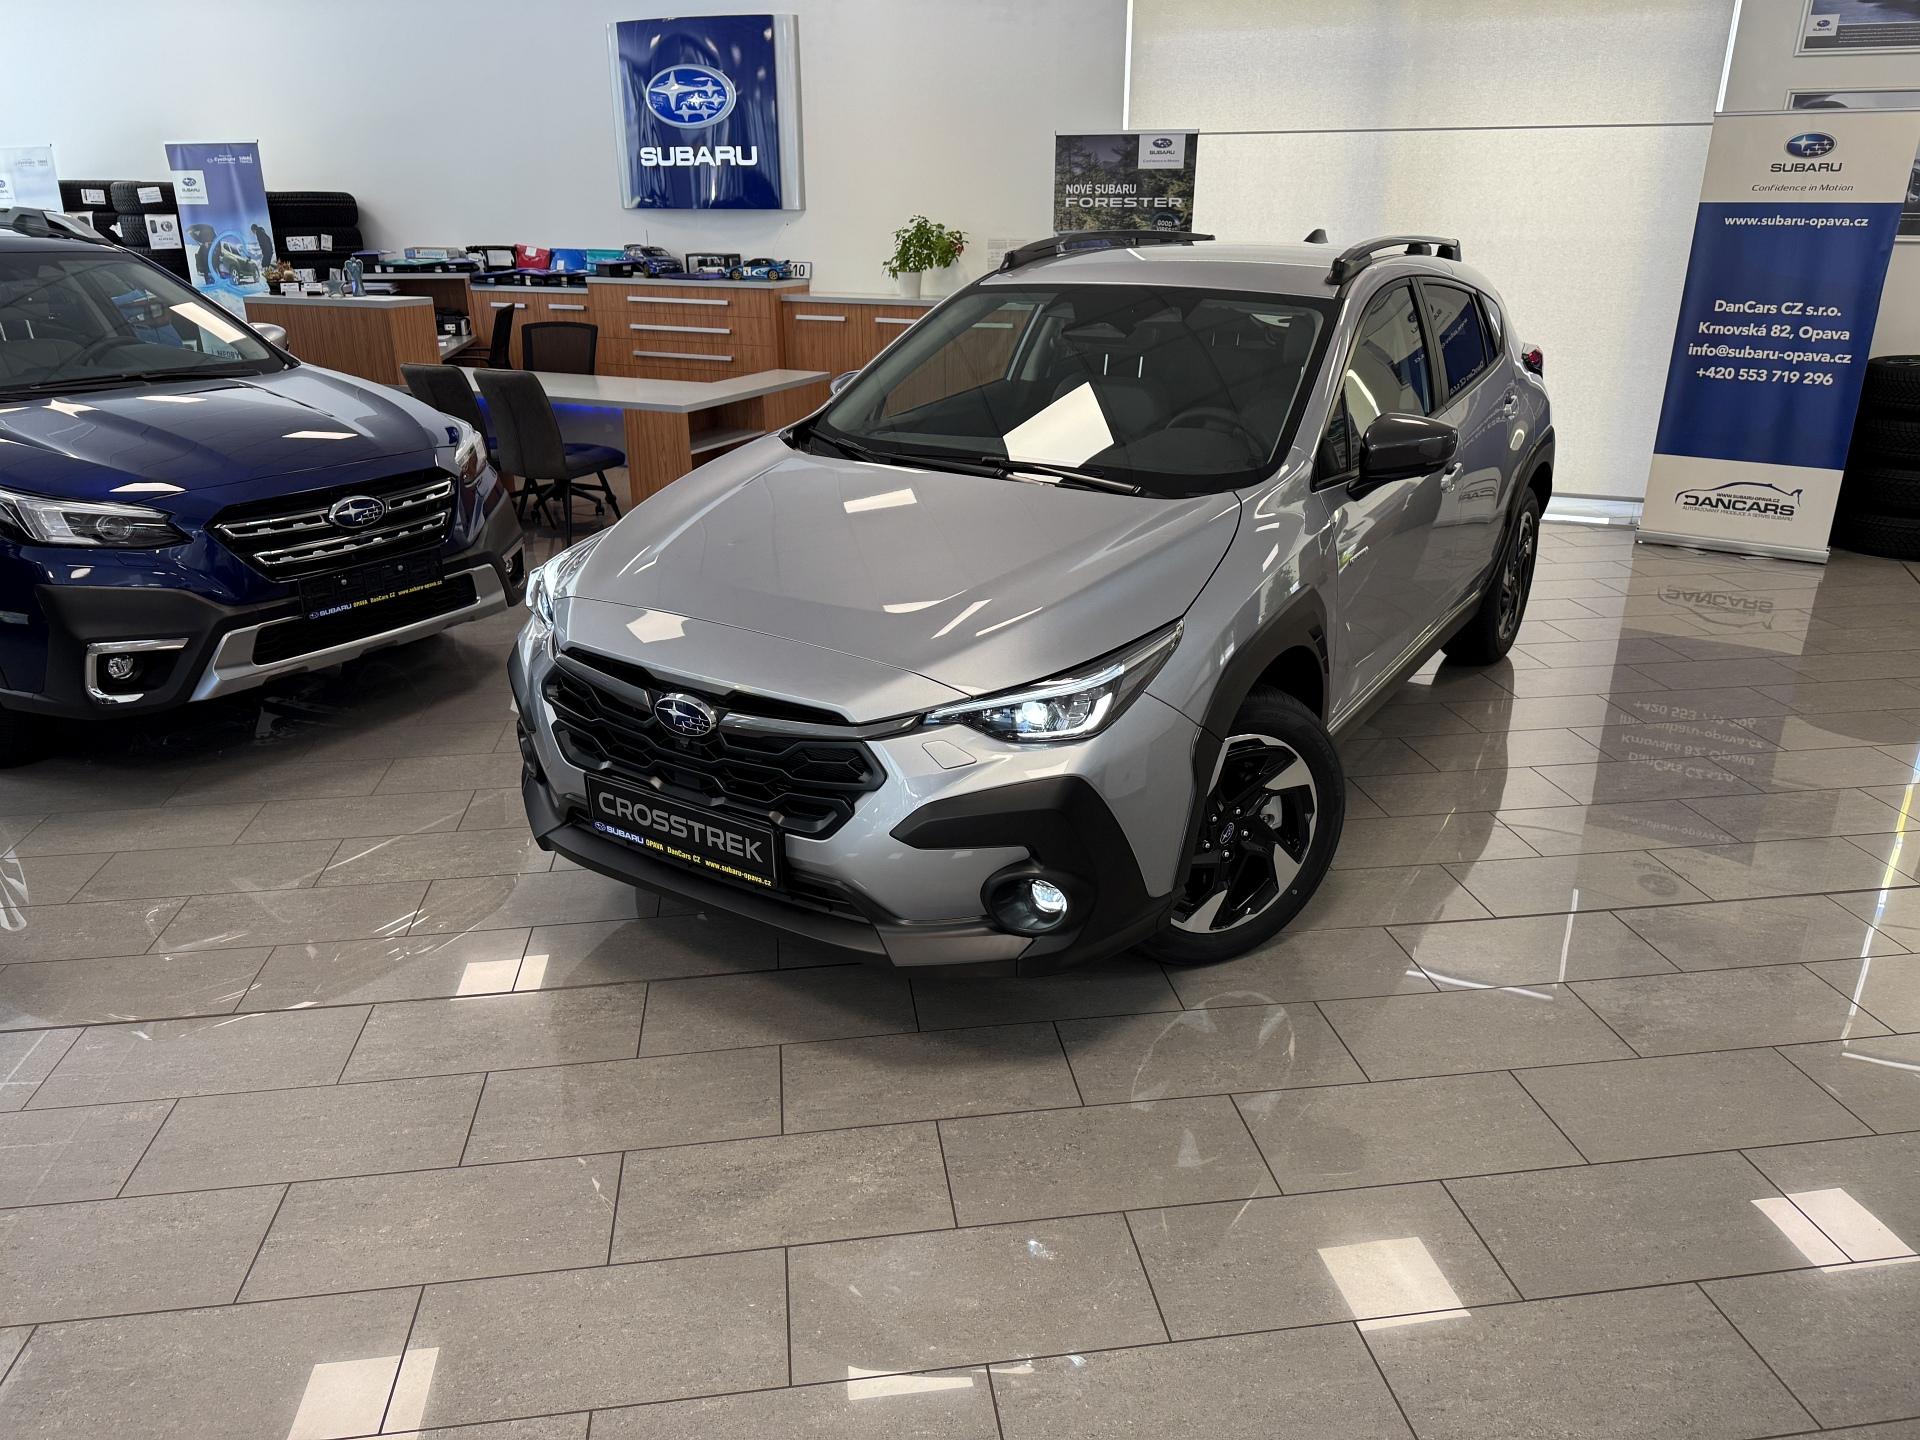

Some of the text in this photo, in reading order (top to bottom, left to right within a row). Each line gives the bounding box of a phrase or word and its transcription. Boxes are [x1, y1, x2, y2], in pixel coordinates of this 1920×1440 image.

[640, 146, 758, 167] SUBARU
[1770, 163, 1842, 172] SUBARU
[1066, 181, 1137, 194] NOVÉ SUBARU
[1751, 184, 1806, 192] Confidence
[1819, 184, 1854, 192] Motion
[1065, 197, 1183, 208] FORESTER
[1724, 215, 1869, 229] www.subaru-opava.cz
[1714, 300, 1842, 316] DanCars CZ s.r.o.
[1698, 322, 1850, 342] Krnovská 82, Opava
[1688, 343, 1852, 364] info@subaru-opava.cz
[1696, 366, 1834, 386] +420 553 719 296
[1683, 494, 1795, 516] DANCARS
[320, 604, 352, 617] SUBARU
[598, 791, 764, 864] CROSSTREK
[606, 825, 772, 887] SUBARU OPAVA DanCars CZ www.subaru-opava.cz
